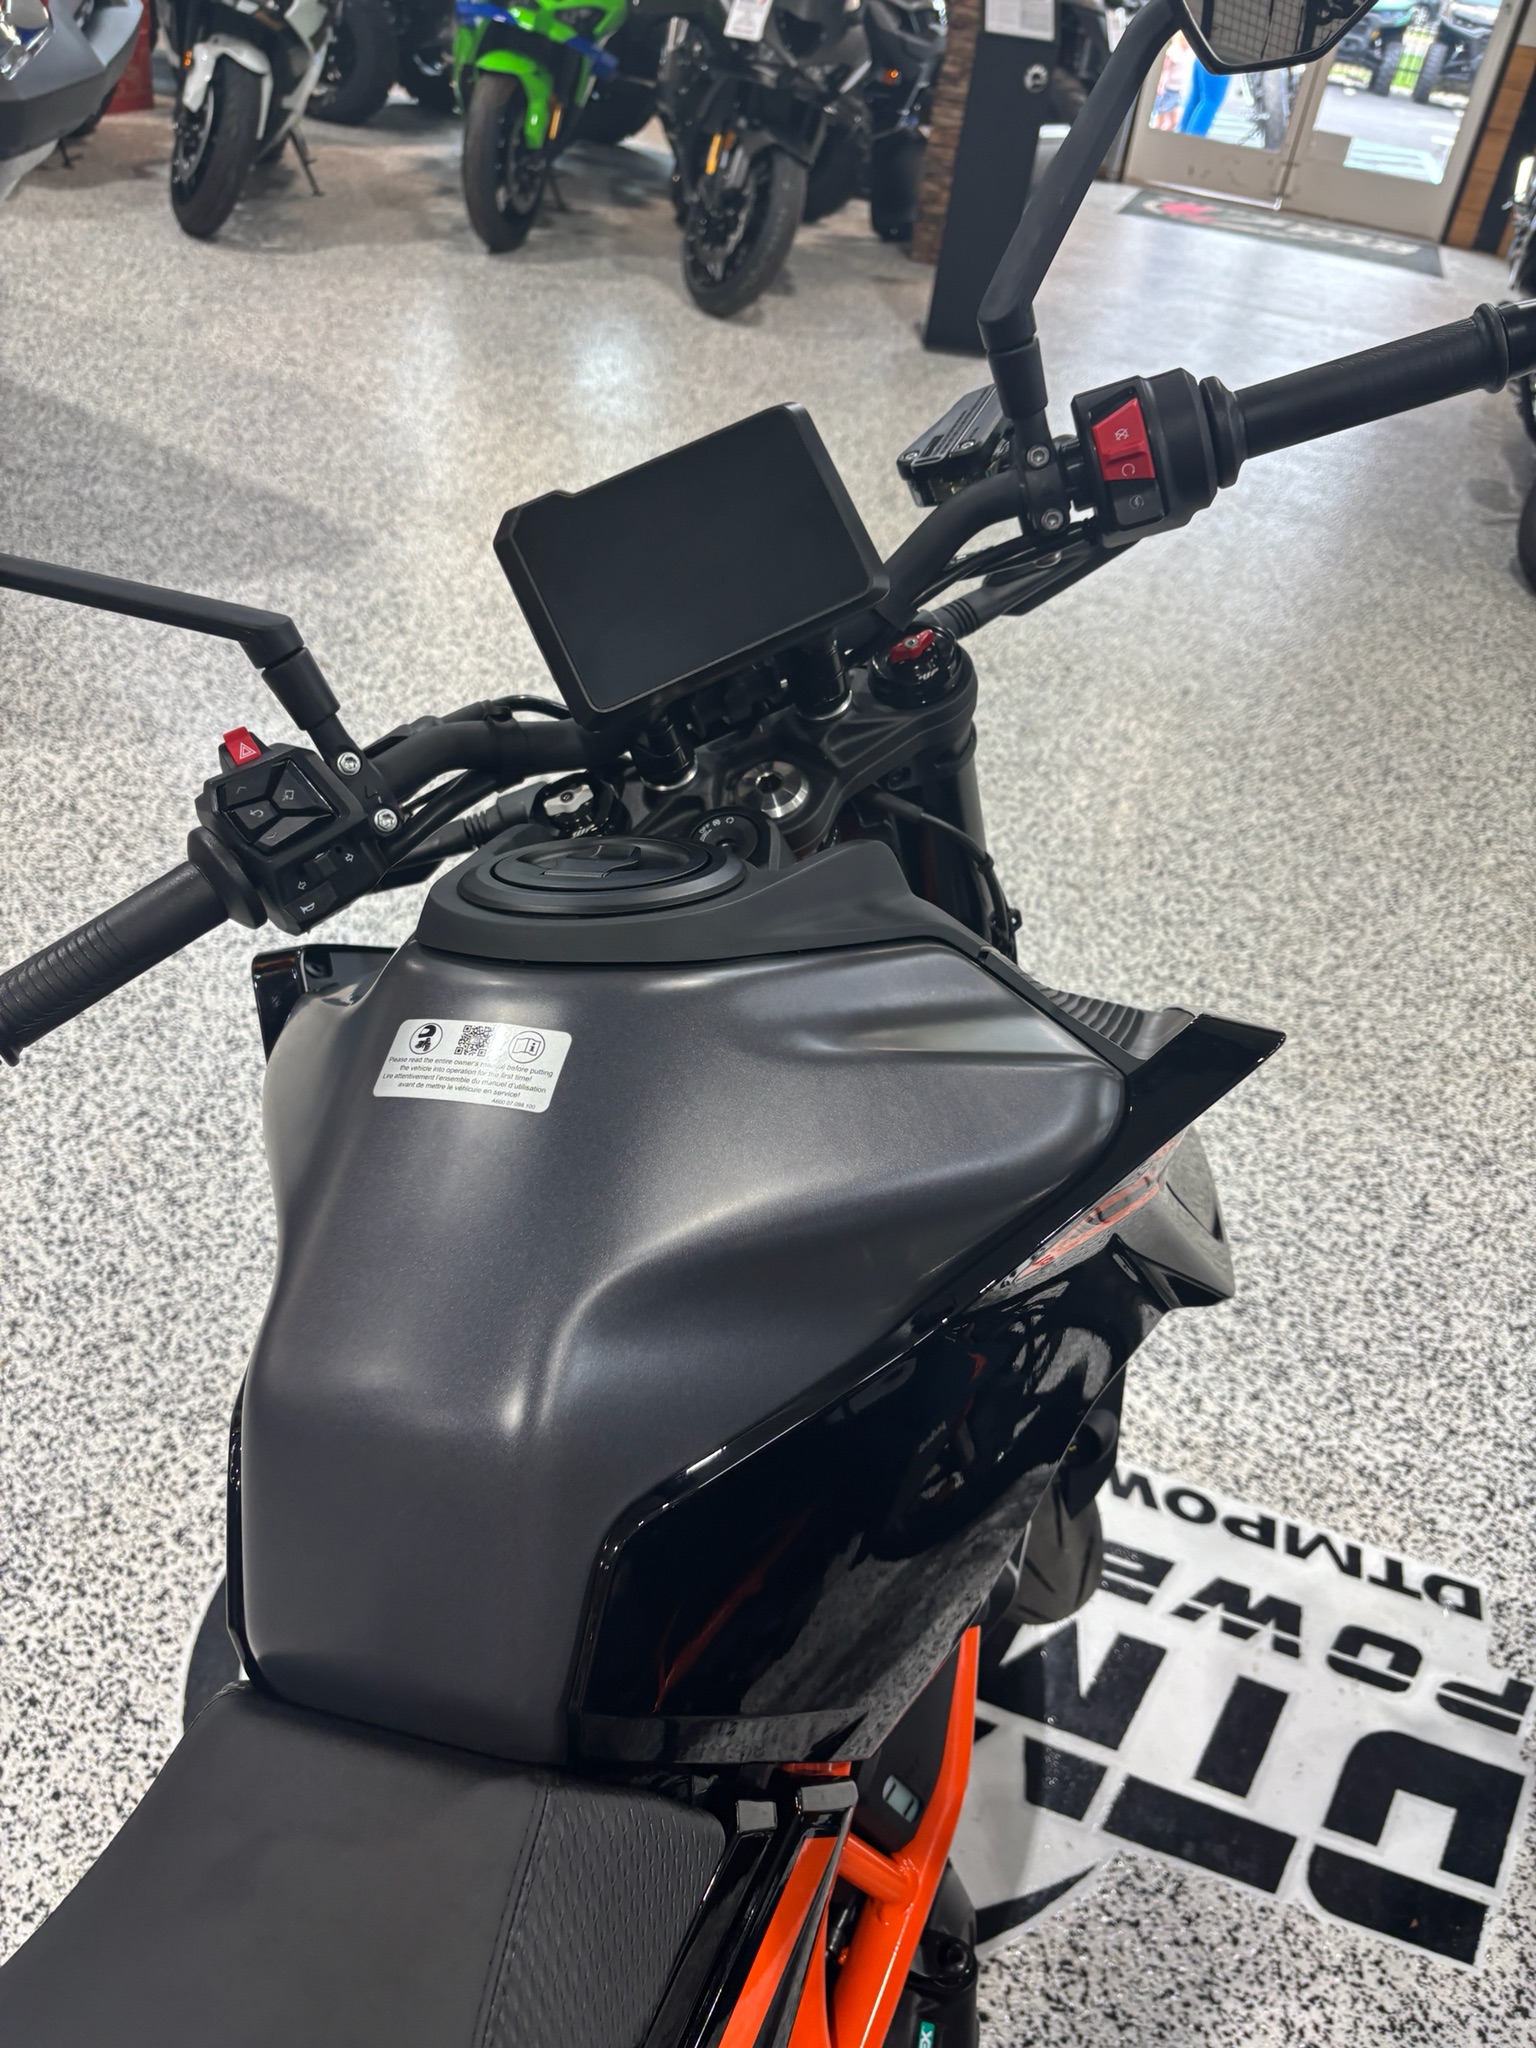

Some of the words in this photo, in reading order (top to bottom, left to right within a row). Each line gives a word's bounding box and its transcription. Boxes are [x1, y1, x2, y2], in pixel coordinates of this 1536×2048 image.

[410, 1064, 432, 1072] vehicle
[445, 1067, 477, 1075] operation
[500, 1072, 514, 1080] first
[514, 1074, 532, 1082] time!
[506, 1065, 529, 1073] before
[529, 1069, 553, 1078] putting
[435, 1075, 471, 1084] l'ensemble
[481, 1079, 507, 1087] manuel
[508, 1082, 546, 1093] d'utilisation
[454, 1085, 482, 1094] véhicule
[492, 1090, 521, 1098] service!
